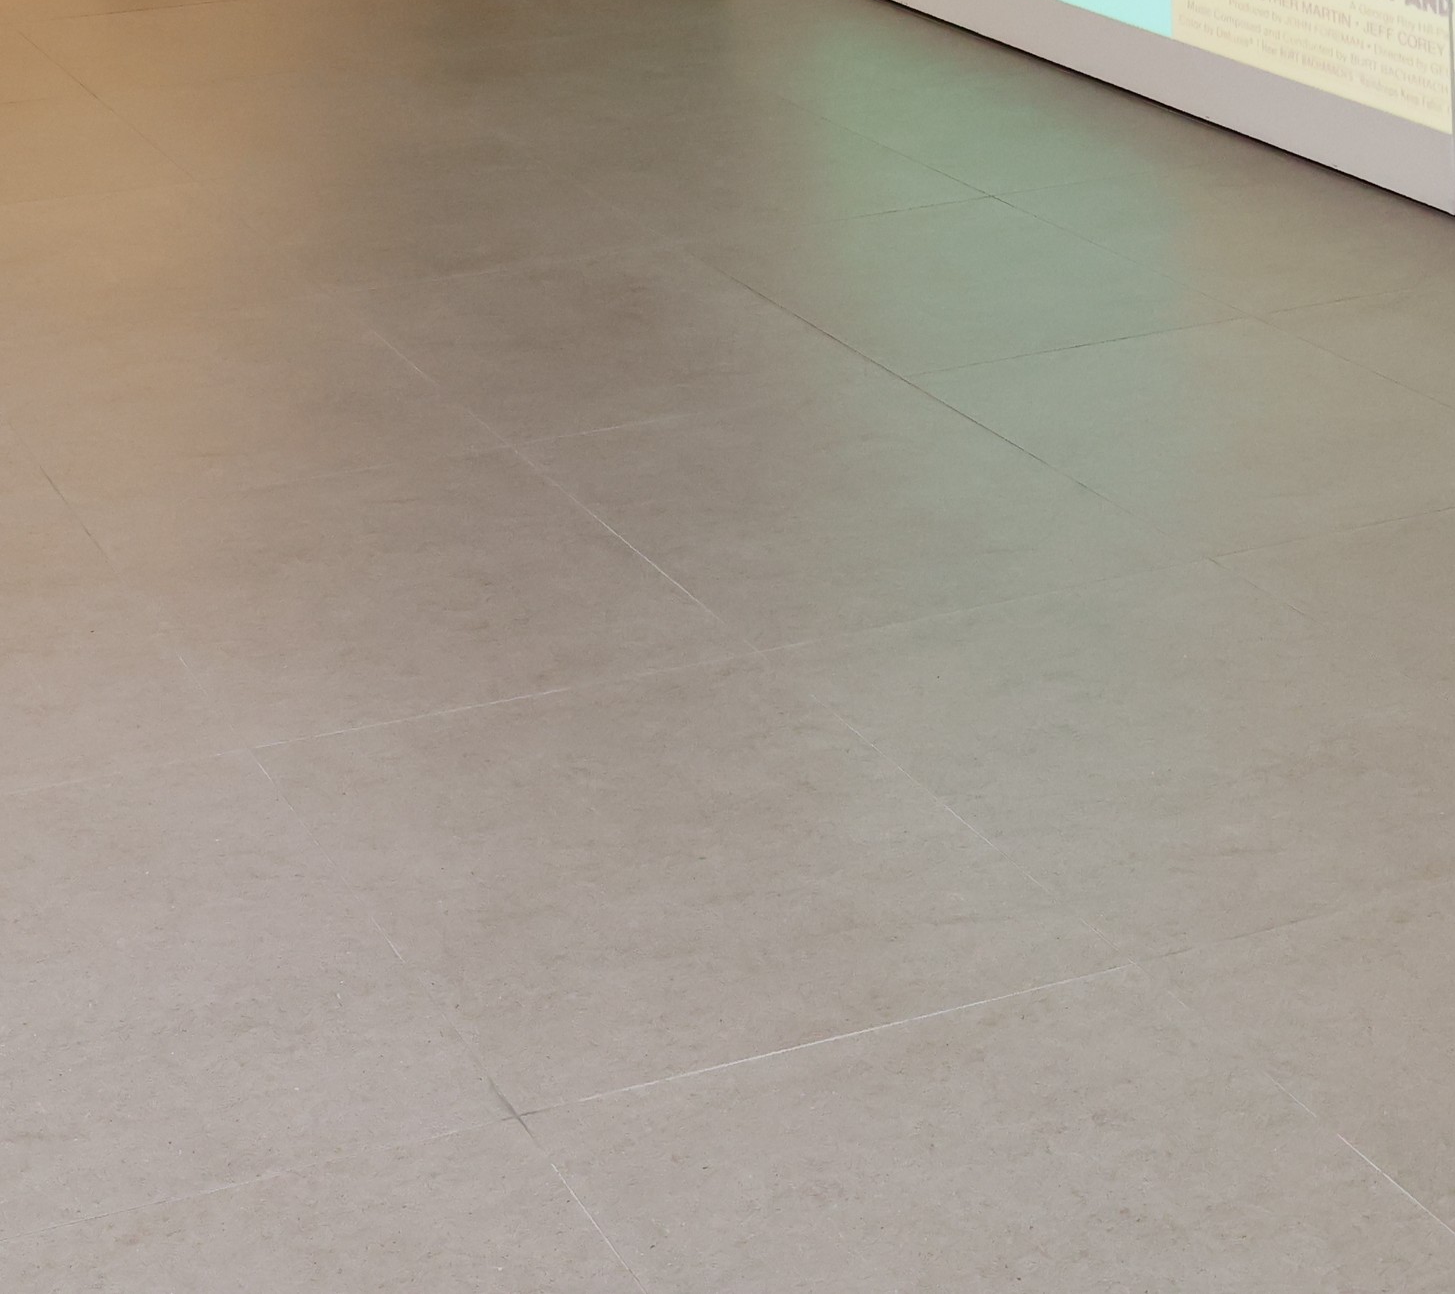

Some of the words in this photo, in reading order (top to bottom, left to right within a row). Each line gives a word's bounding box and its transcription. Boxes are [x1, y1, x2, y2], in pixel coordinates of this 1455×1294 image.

[1302, 0, 1352, 29] MARTIN
[1363, 20, 1393, 40] JEFF
[1397, 29, 1445, 56] COREY
